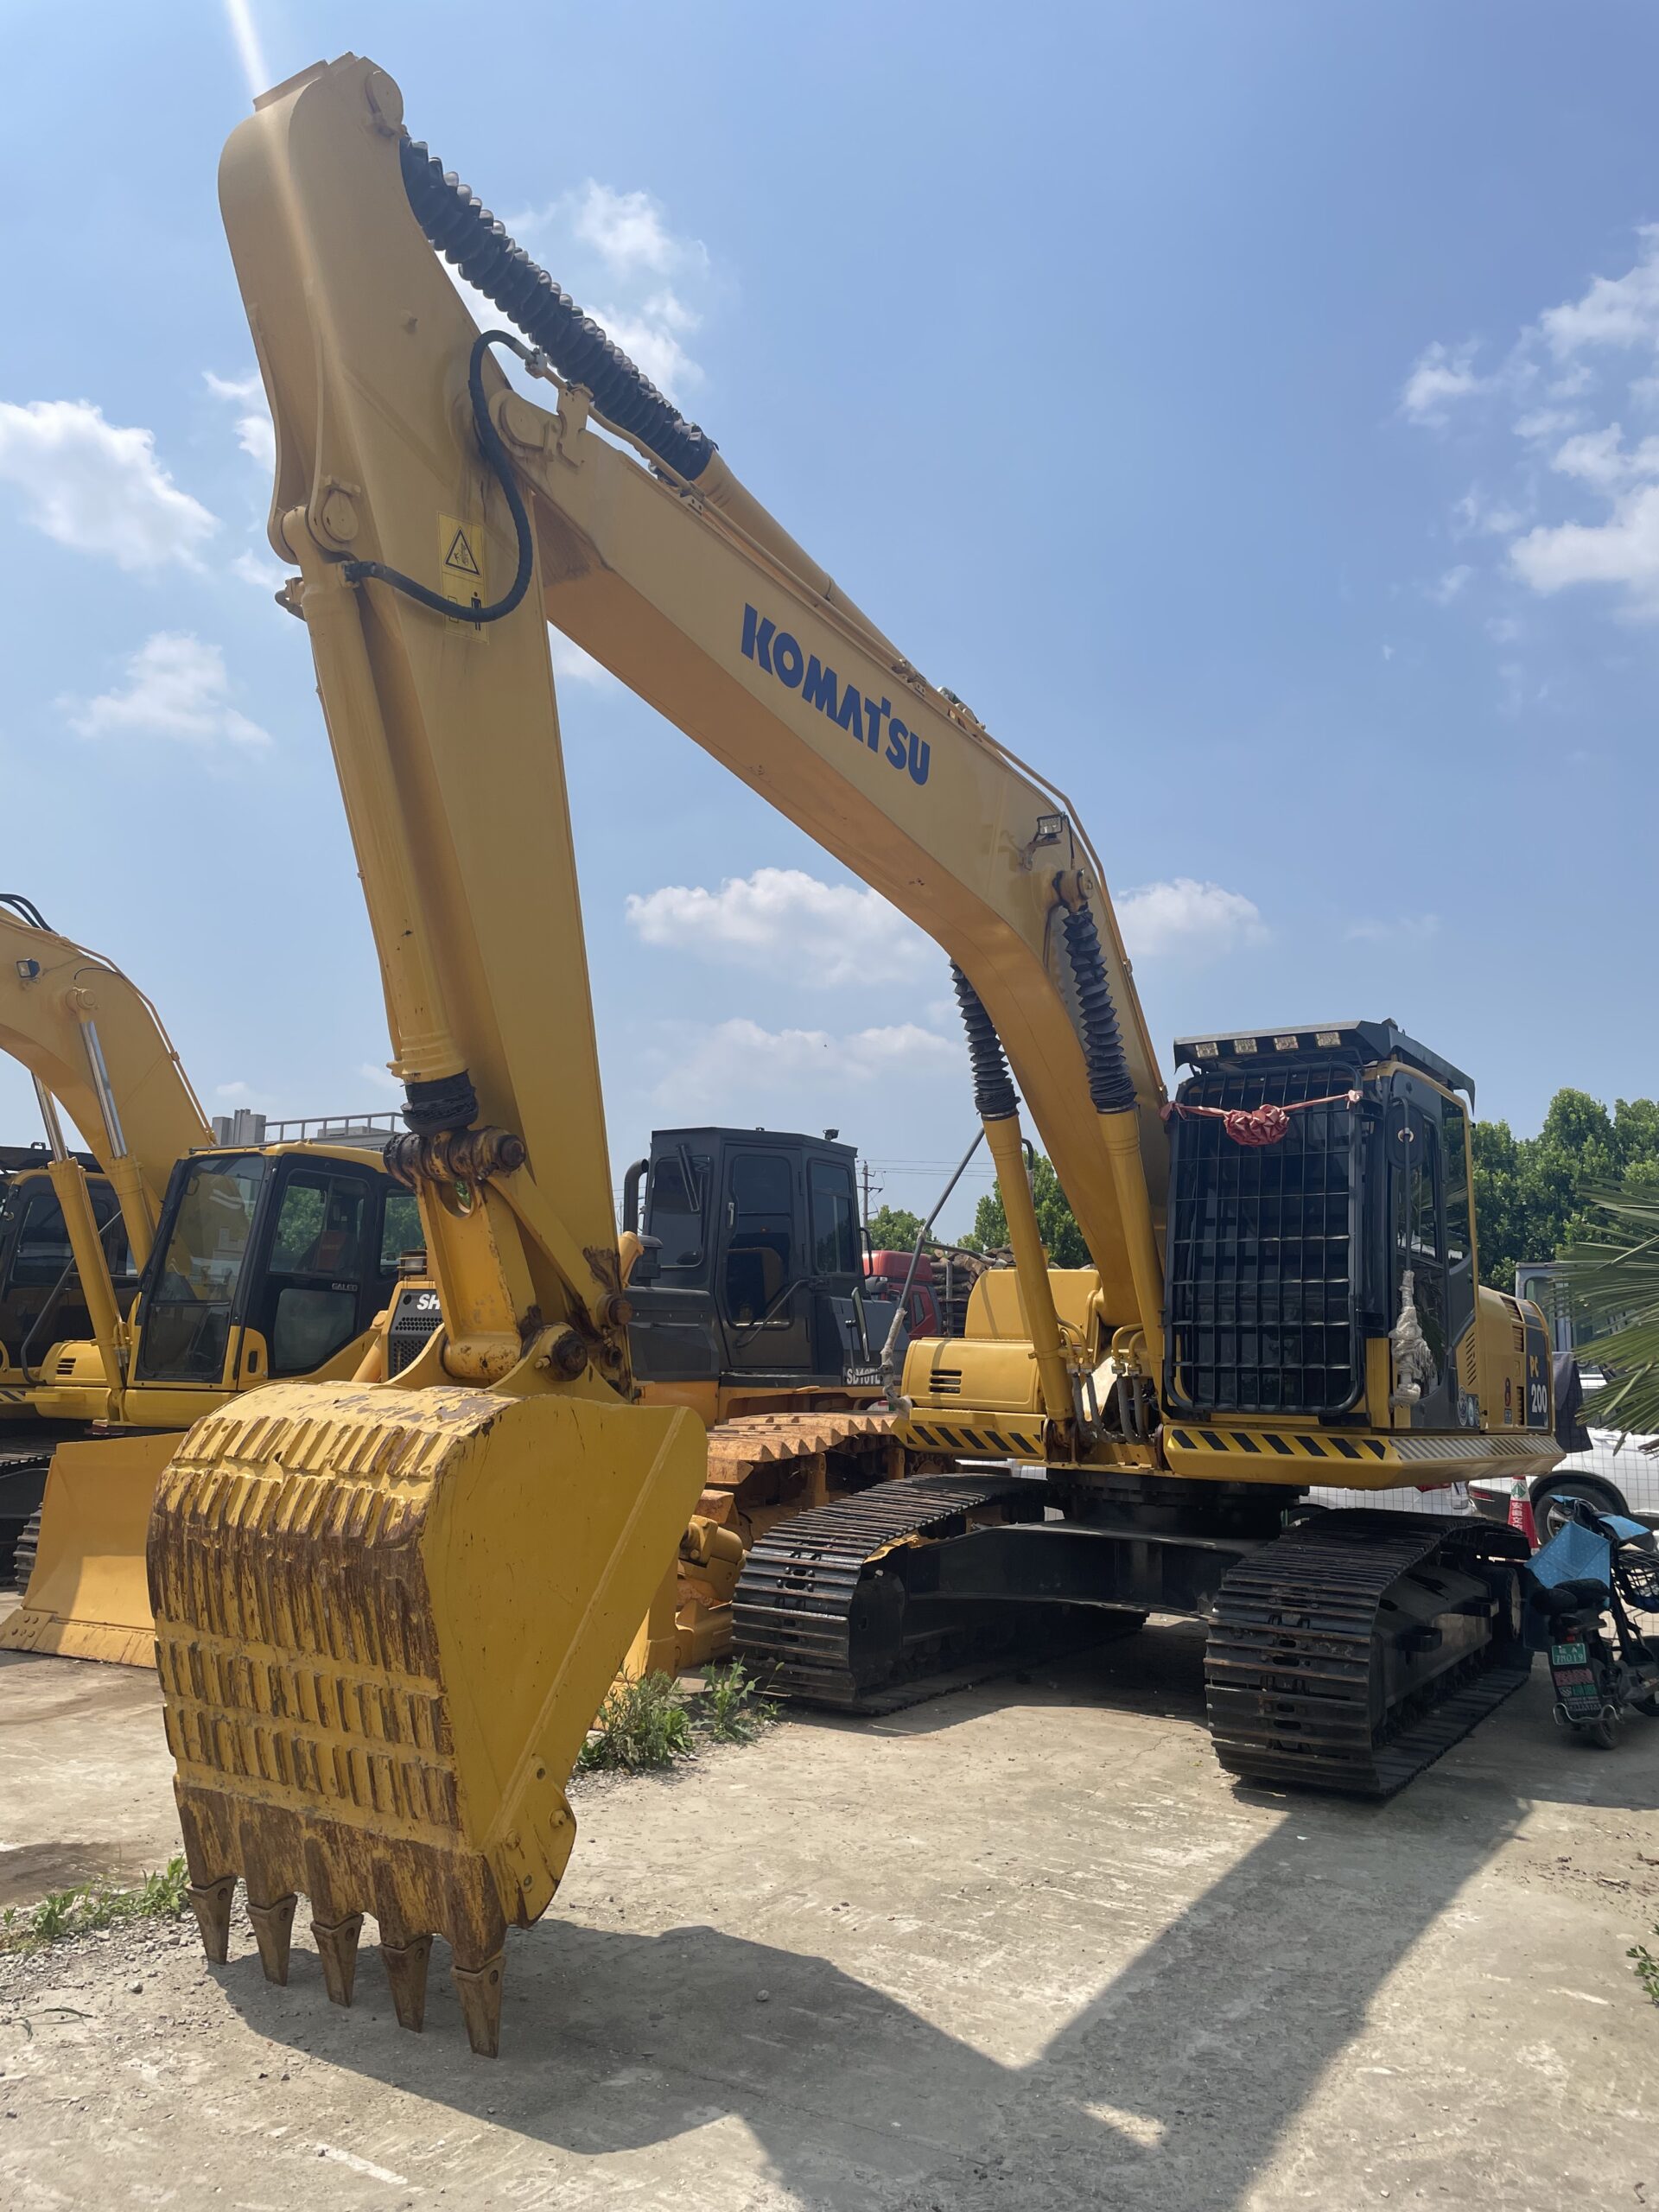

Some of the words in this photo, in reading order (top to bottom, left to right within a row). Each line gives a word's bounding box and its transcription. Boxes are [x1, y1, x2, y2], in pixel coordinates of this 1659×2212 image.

[741, 602, 930, 785] KOMATSU
[1529, 1355, 1539, 1377] PC
[1531, 1383, 1548, 1414] 200
